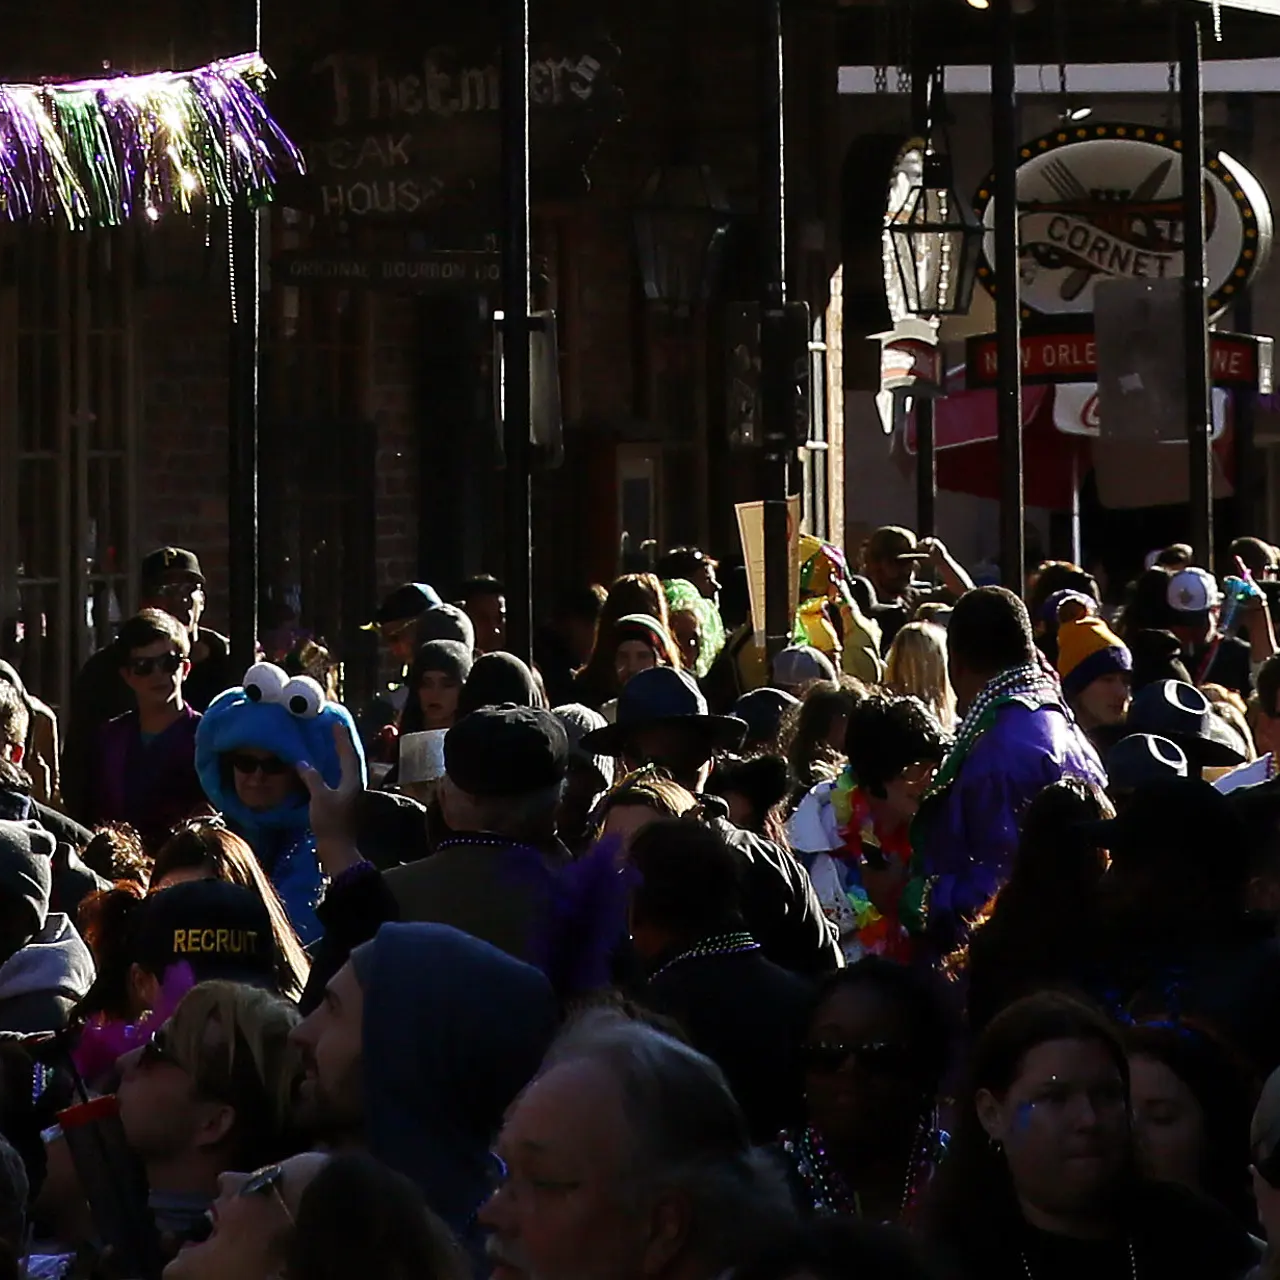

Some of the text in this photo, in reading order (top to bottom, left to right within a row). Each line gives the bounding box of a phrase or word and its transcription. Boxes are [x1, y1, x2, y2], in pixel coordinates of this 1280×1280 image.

[423, 44, 601, 116] Emers
[288, 132, 412, 173] TEAK
[1047, 215, 1173, 278] CORNET
[1042, 342, 1097, 367] ORLE
[172, 928, 258, 954] RECRUIT
